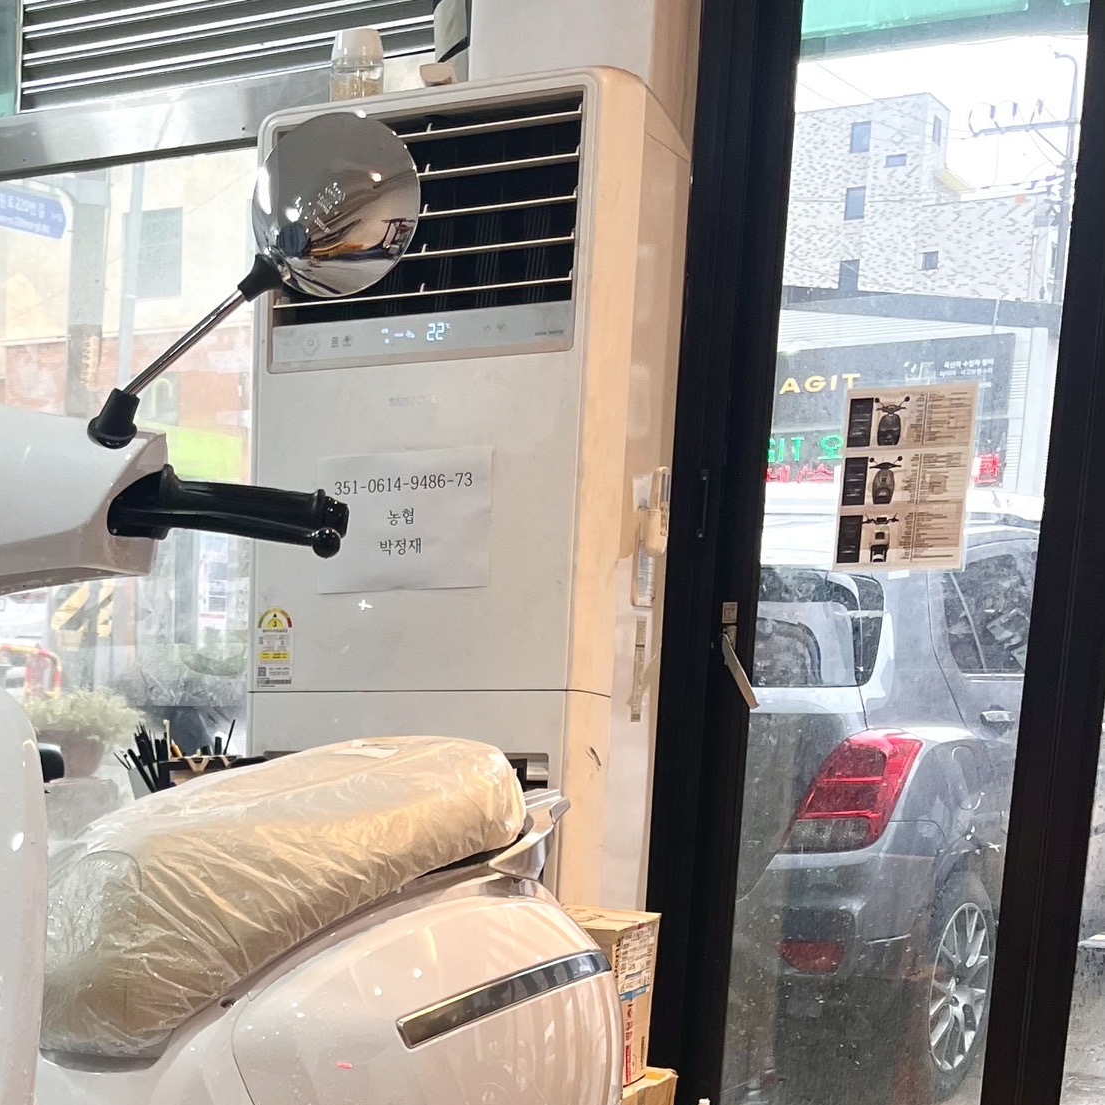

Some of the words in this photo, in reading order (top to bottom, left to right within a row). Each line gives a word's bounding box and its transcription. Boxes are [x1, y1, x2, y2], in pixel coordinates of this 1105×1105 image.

[779, 372, 861, 395] AGIT
[333, 471, 474, 497] 351-0614-9486-73
[386, 507, 415, 526] 농협
[378, 538, 423, 556] 박정재
